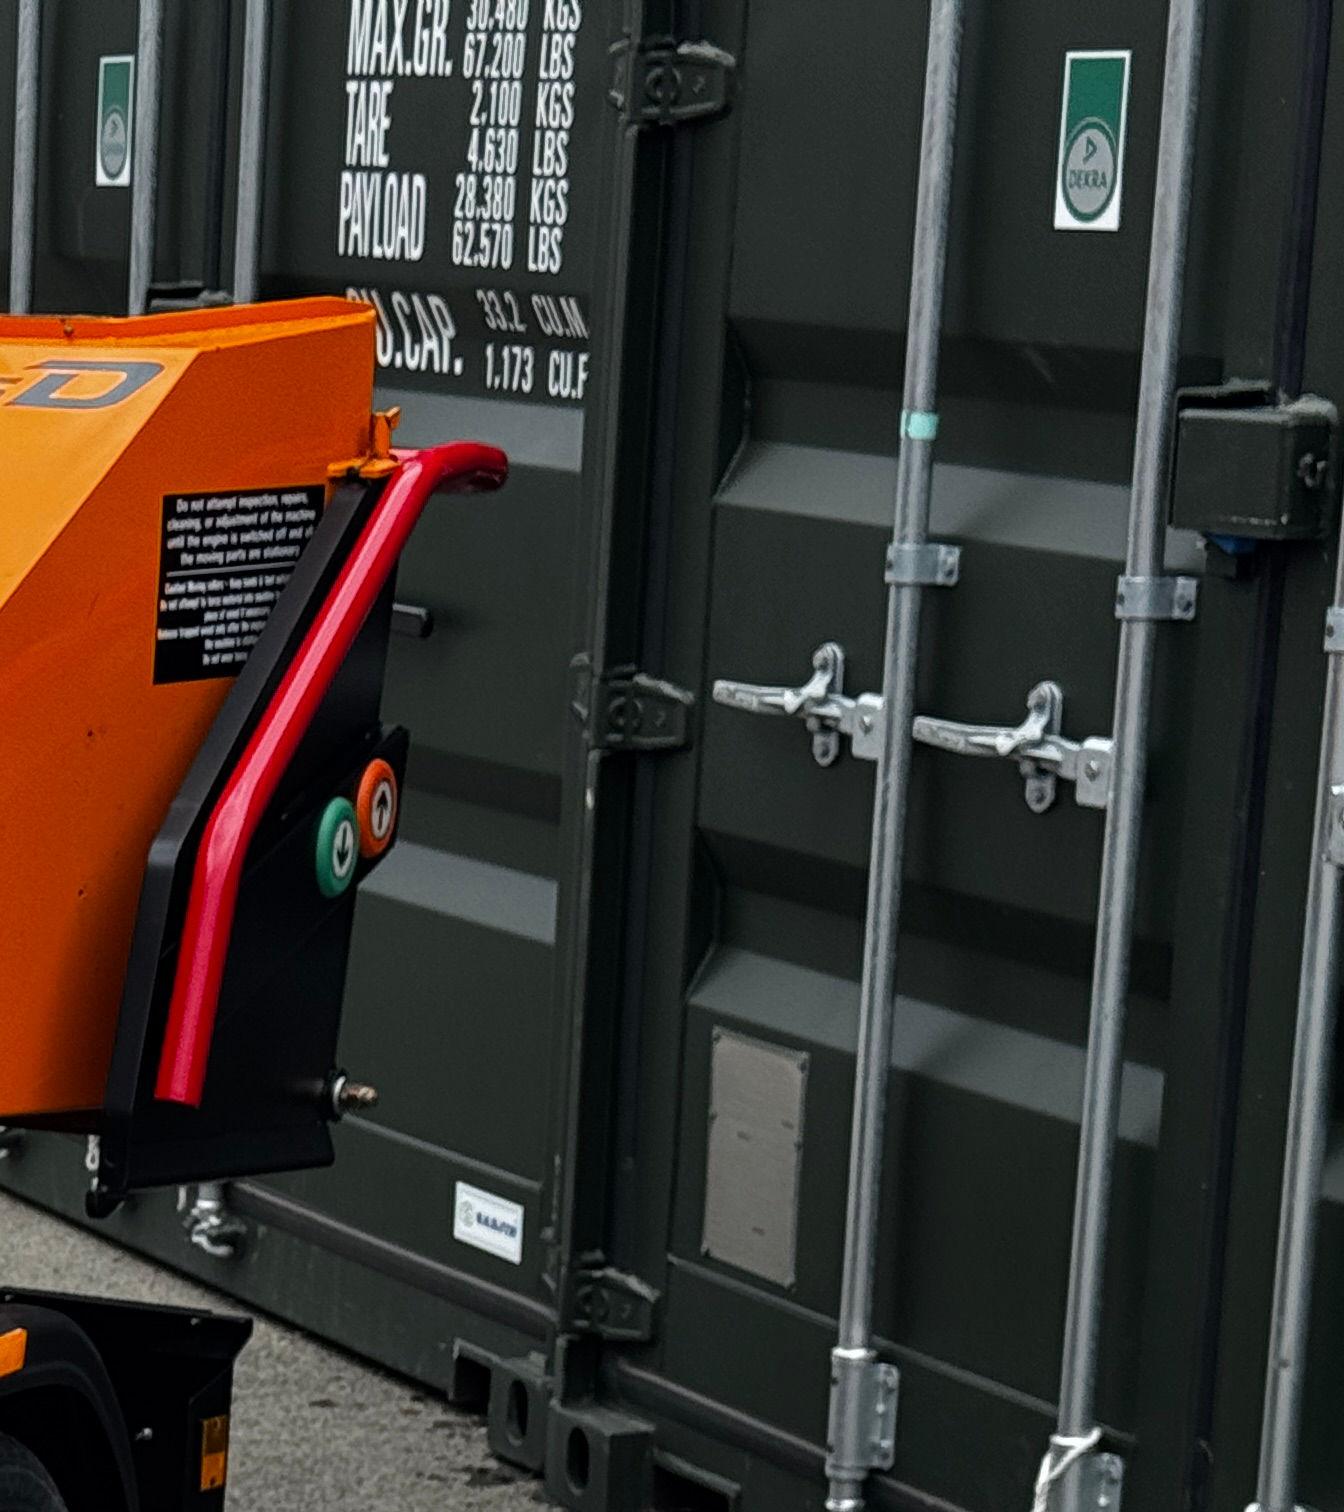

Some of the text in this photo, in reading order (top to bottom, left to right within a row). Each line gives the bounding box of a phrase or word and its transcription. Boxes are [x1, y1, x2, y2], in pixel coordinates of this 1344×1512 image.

[347, 0, 453, 77] MAX.GR.
[543, 0, 582, 31] KGS
[539, 32, 575, 80] LBS
[345, 80, 394, 167] TARE
[535, 81, 575, 129] KGS
[532, 129, 569, 177] LBS
[1068, 169, 1108, 189] DEKRA
[338, 171, 428, 262] PAYLOAD
[529, 178, 569, 226] KGS
[528, 225, 563, 275] LBS
[346, 287, 464, 376] U.CAP.
